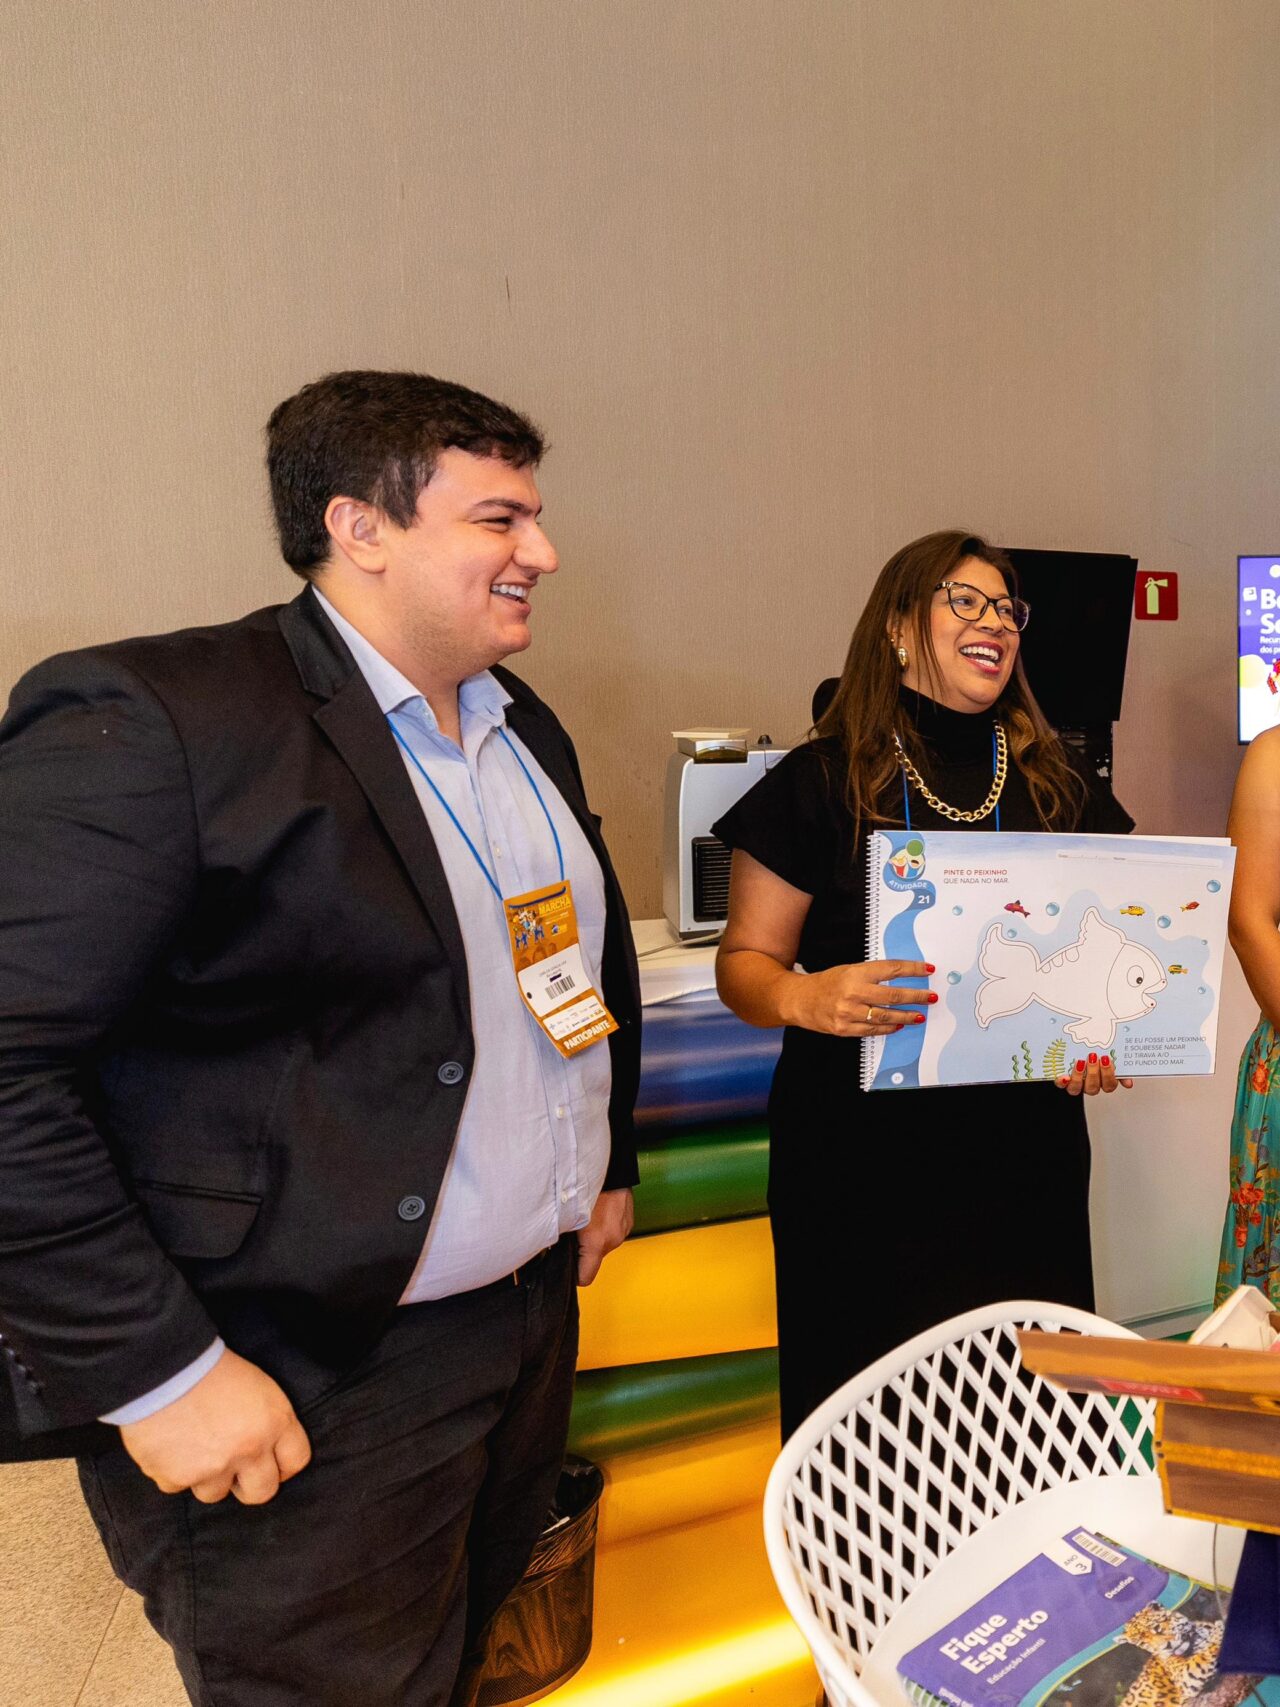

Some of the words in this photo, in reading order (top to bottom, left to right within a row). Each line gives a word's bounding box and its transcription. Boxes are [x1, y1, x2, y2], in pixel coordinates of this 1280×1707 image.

[888, 879, 928, 889] ATIVIDADE
[918, 895, 930, 904] 21
[563, 1020, 611, 1050] PARTICIPANTE
[1063, 1554, 1078, 1566] ANO
[1075, 1563, 1087, 1571] 3
[1104, 1576, 1135, 1599] Desafios
[939, 1614, 1008, 1661] Fique
[960, 1610, 1049, 1675] Esperto
